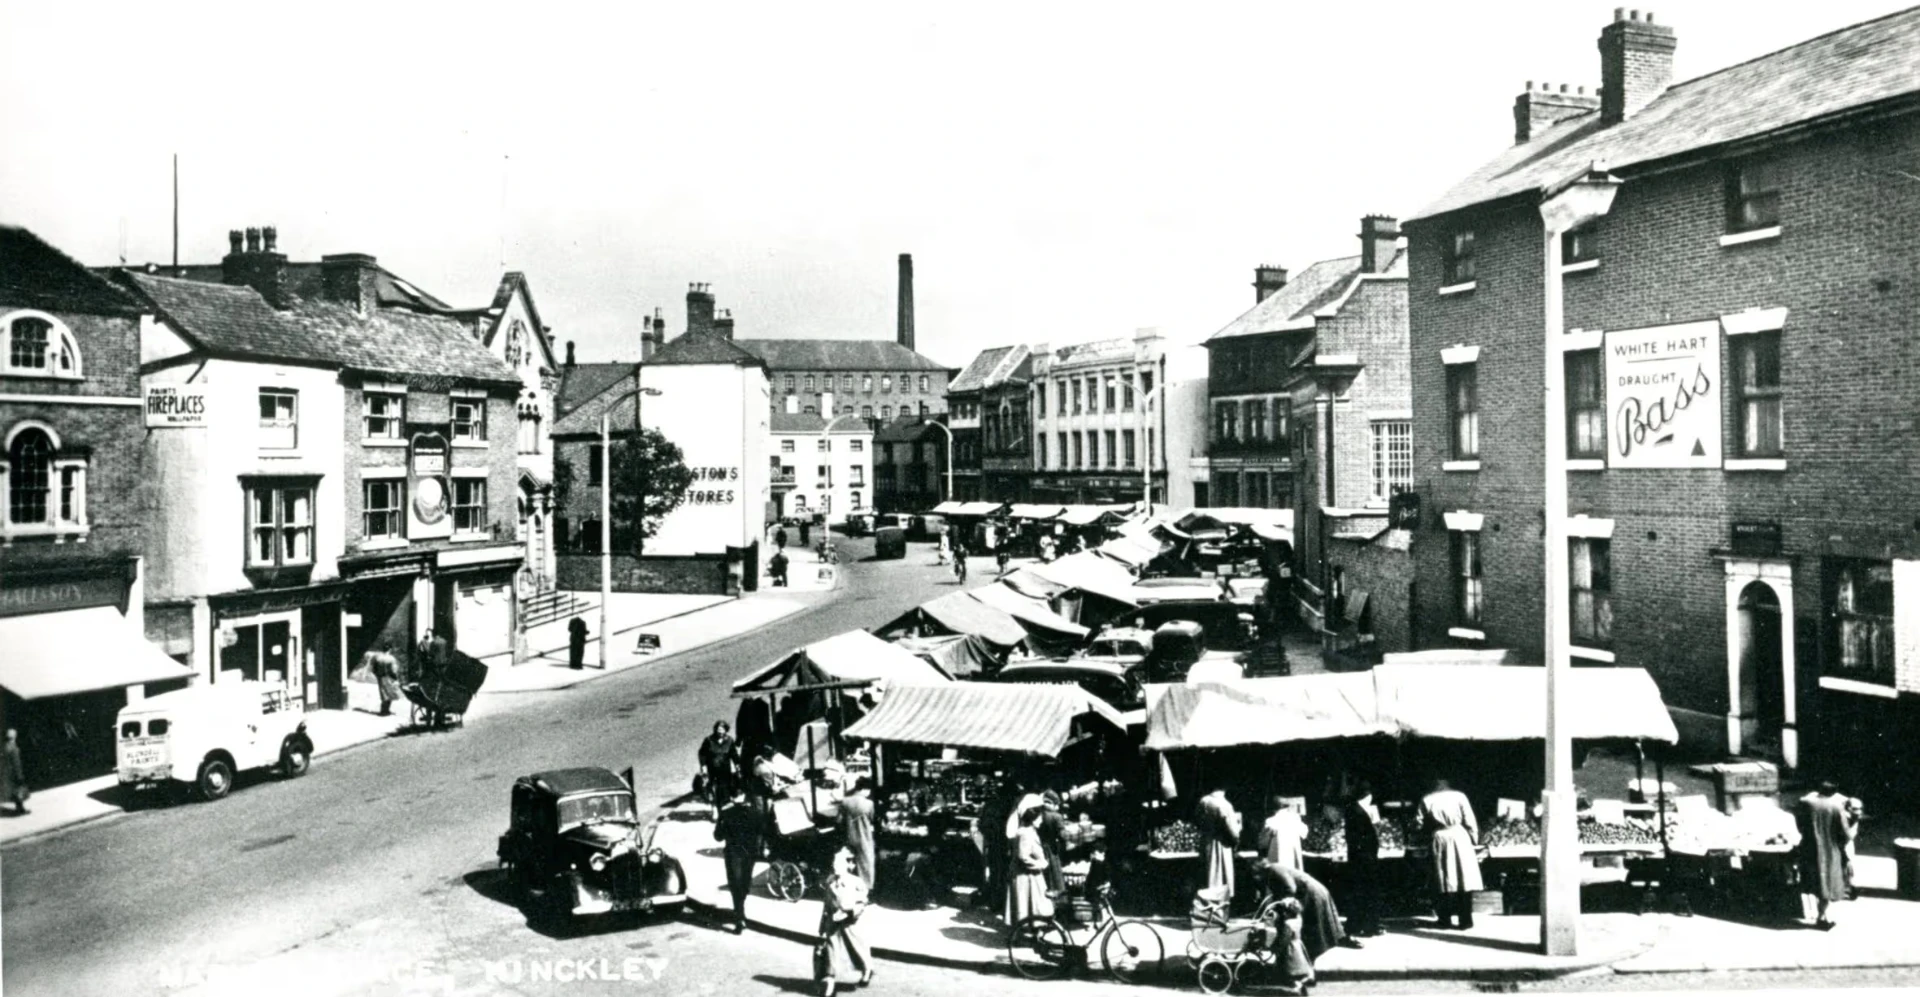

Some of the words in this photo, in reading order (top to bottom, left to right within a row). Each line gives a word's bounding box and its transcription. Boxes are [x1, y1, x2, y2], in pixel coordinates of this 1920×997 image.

[1615, 341, 1657, 356] WHITE
[1667, 336, 1707, 351] HART
[1618, 372, 1677, 387] DRAUGHT
[147, 395, 205, 414] FIREPLACES
[1616, 362, 1710, 458] Bass
[685, 490, 734, 504] TORES
